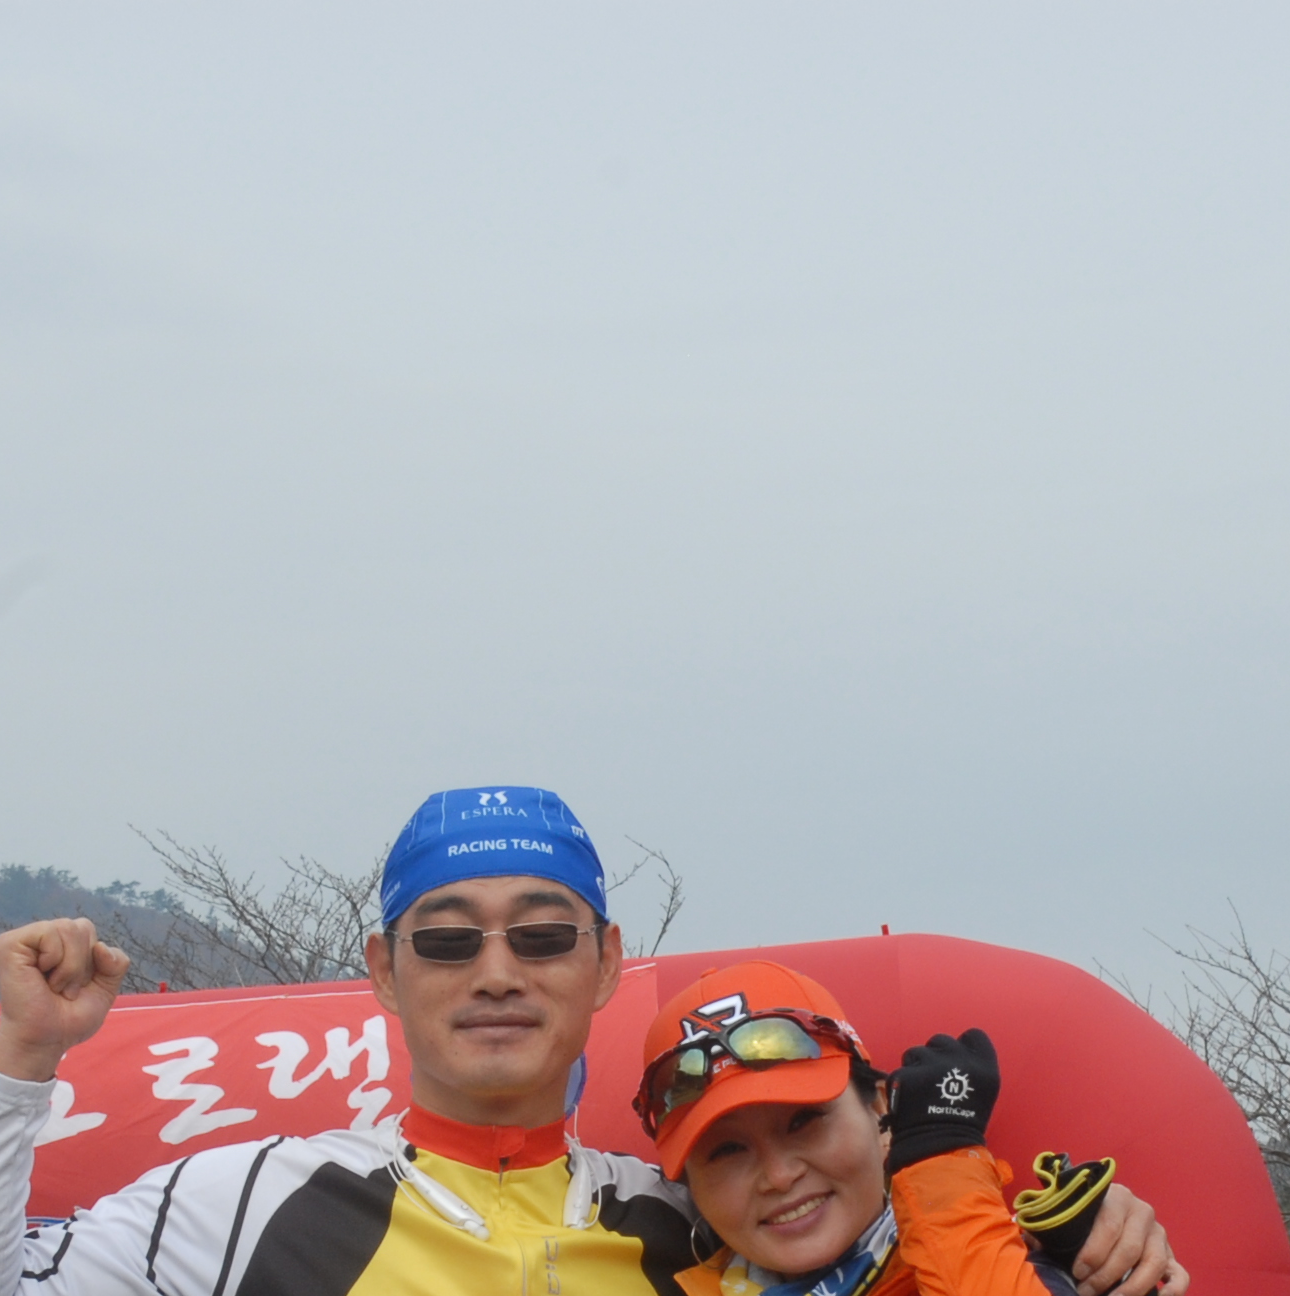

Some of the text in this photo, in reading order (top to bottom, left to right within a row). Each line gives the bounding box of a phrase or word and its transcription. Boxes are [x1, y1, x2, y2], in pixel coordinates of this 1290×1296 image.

[461, 805, 528, 820] ESPERA
[447, 838, 553, 857] RACING TEAM
[928, 1105, 976, 1118] NorthCape
